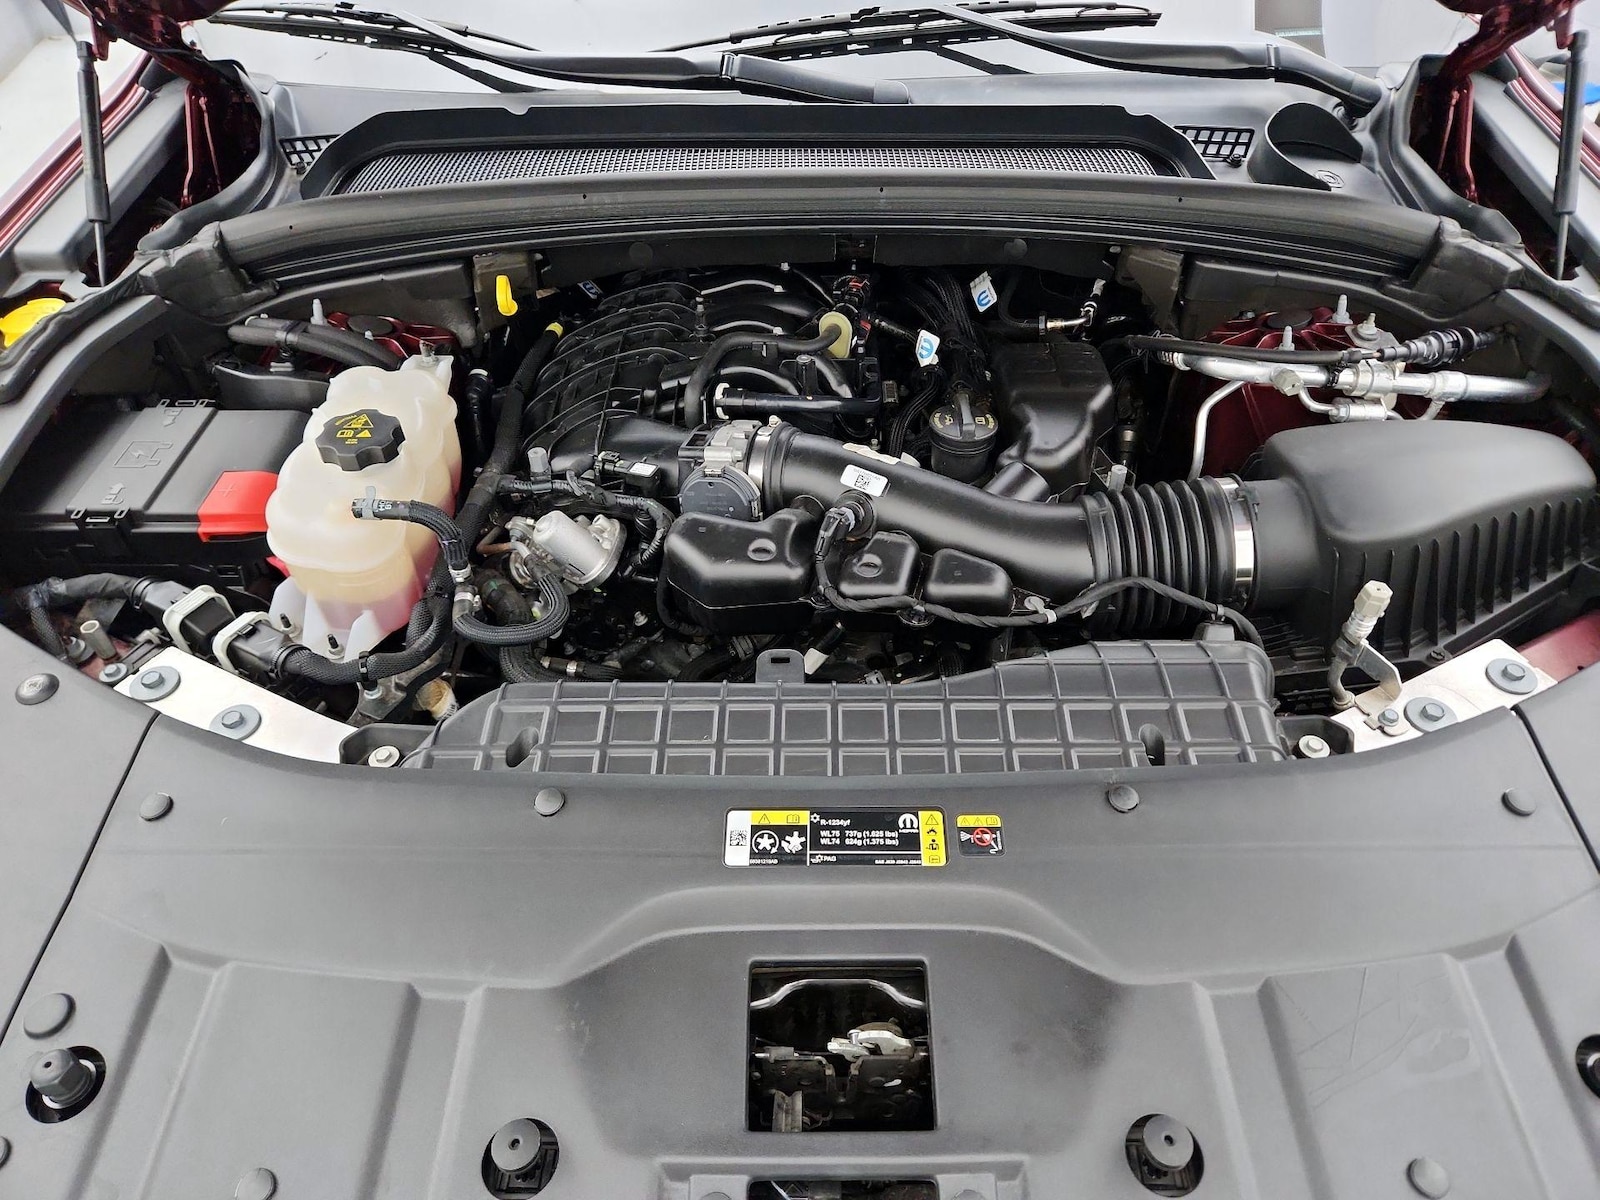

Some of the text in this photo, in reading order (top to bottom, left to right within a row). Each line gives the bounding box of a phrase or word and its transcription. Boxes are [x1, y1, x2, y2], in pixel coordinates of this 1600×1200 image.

[845, 830, 862, 838] 737g
[885, 830, 898, 838] lbs)
[885, 838, 899, 846] lbs)
